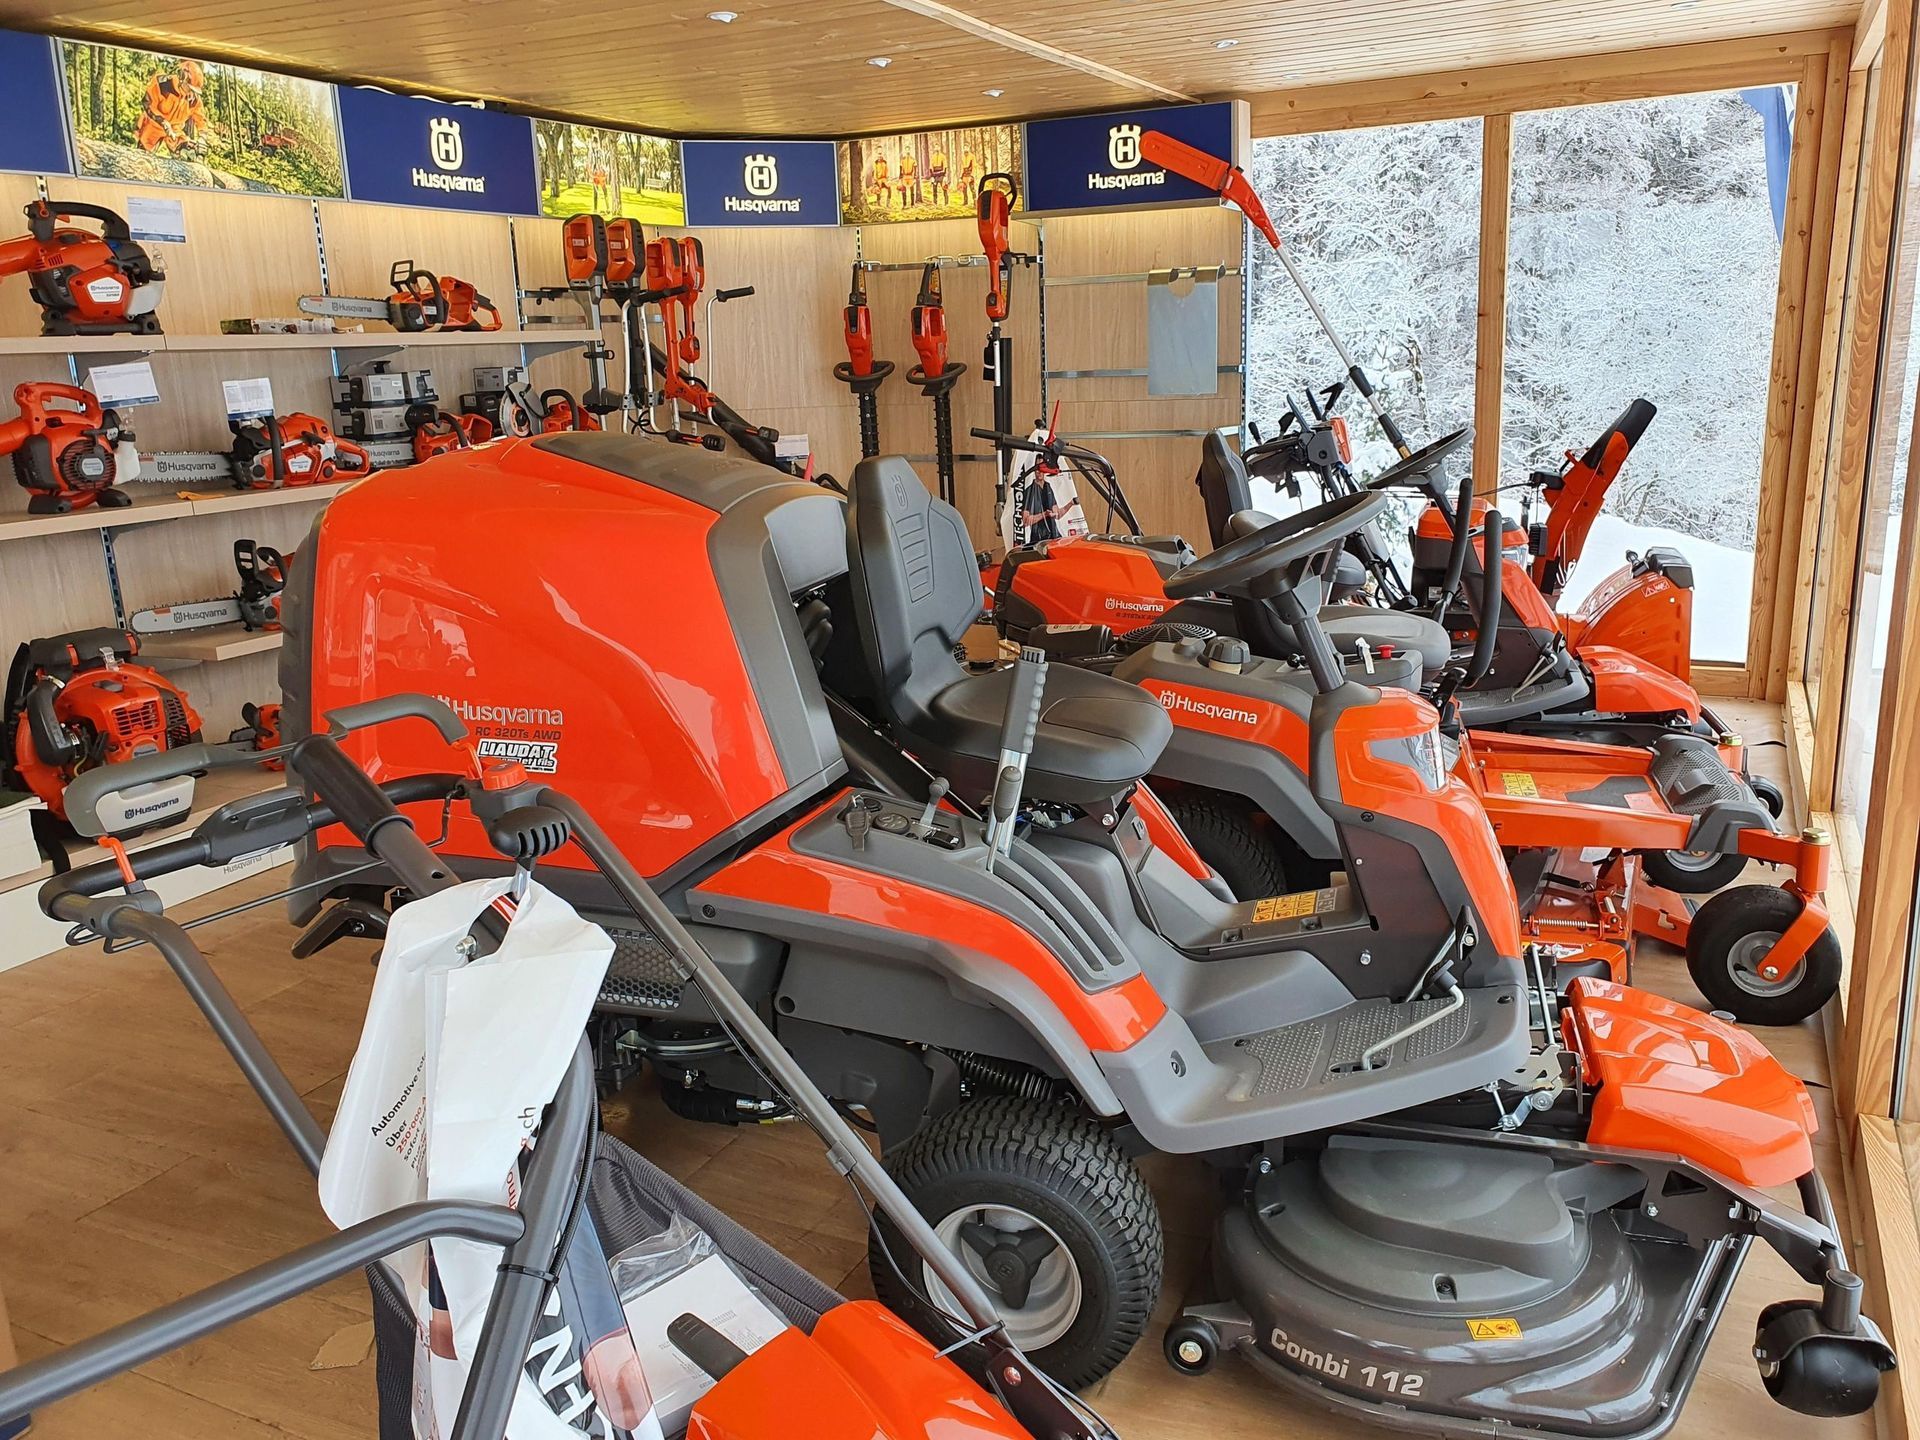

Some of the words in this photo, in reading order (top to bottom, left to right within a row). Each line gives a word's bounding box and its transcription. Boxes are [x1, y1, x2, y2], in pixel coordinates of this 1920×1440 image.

[412, 168, 485, 193] Husqvarna
[1088, 169, 1166, 190] Husqvarna
[724, 196, 801, 214] Husqvarna
[338, 303, 372, 313] Husqvarna
[168, 461, 217, 475] Husqvarna
[183, 607, 228, 621] Husqvarna
[1115, 599, 1164, 612] Husqvarna
[453, 700, 563, 725] Husqvarna
[1175, 694, 1258, 725] Husqvarna
[475, 726, 491, 736] RC
[495, 727, 529, 739] 320Ts
[533, 729, 562, 740] AWD
[481, 742, 554, 758] LIAUDAT
[135, 796, 180, 816] Husqvarna
[371, 1074, 418, 1137] Automotive
[385, 1120, 407, 1148] Über
[1270, 1327, 1350, 1380] Combi
[1360, 1365, 1424, 1397] 112
